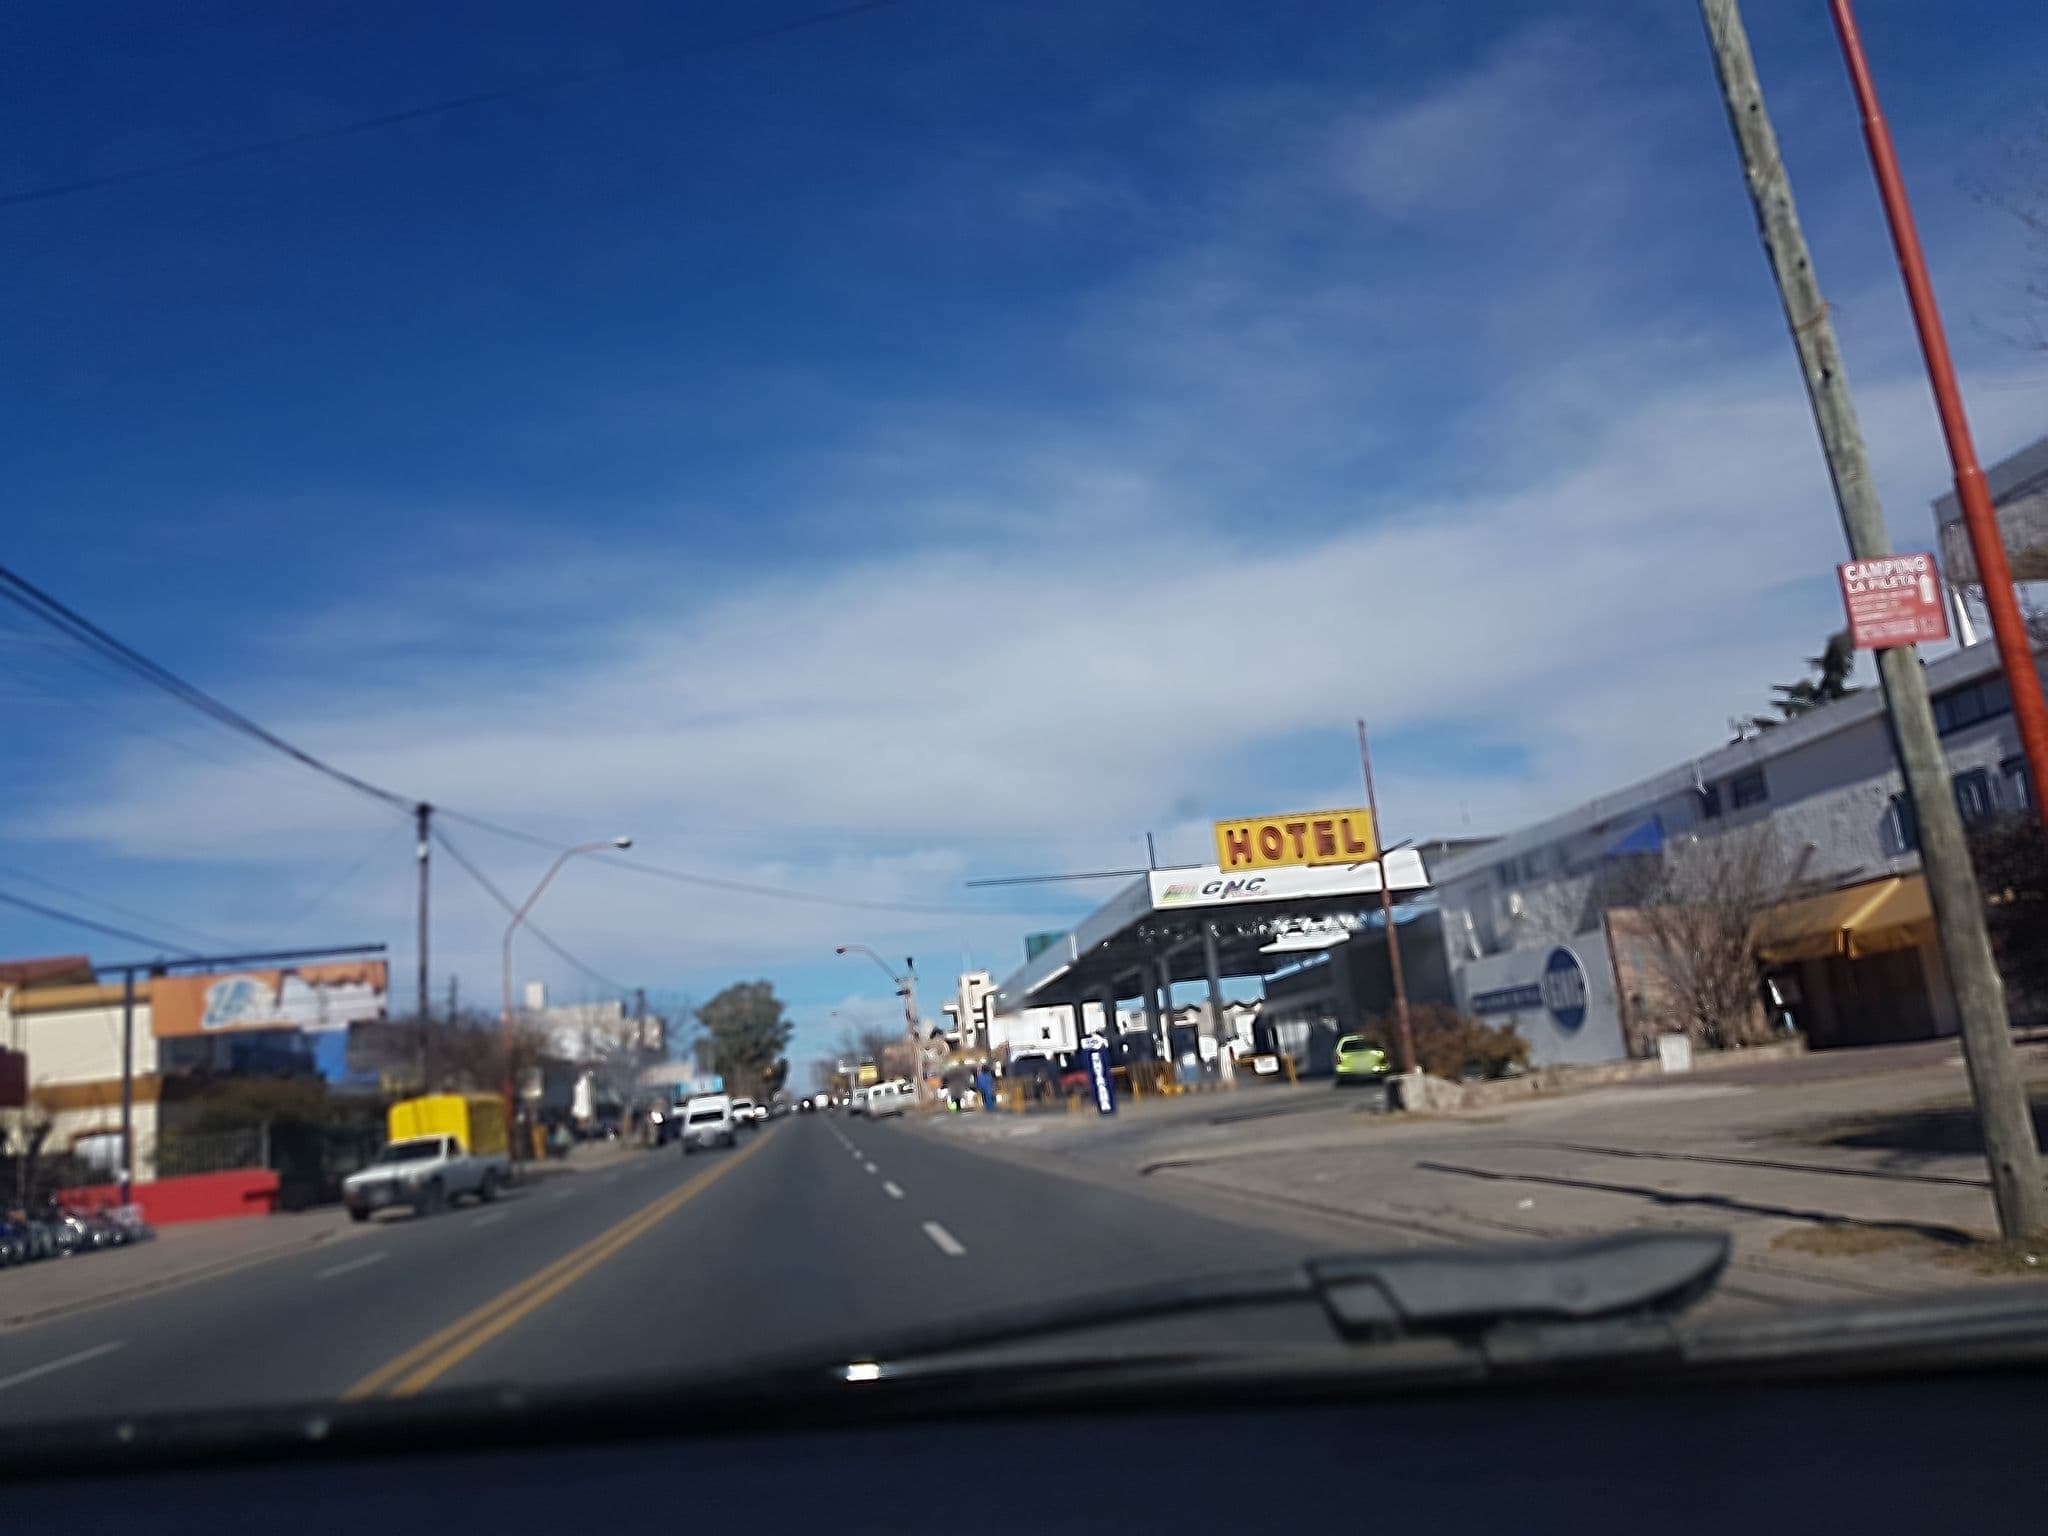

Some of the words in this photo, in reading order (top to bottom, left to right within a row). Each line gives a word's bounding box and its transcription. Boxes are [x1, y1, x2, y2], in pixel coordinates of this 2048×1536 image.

[1845, 556, 1927, 581] CAMPING
[1847, 581, 1866, 593] LA
[1226, 817, 1366, 865] HOTEL
[1202, 877, 1266, 899] GNC
